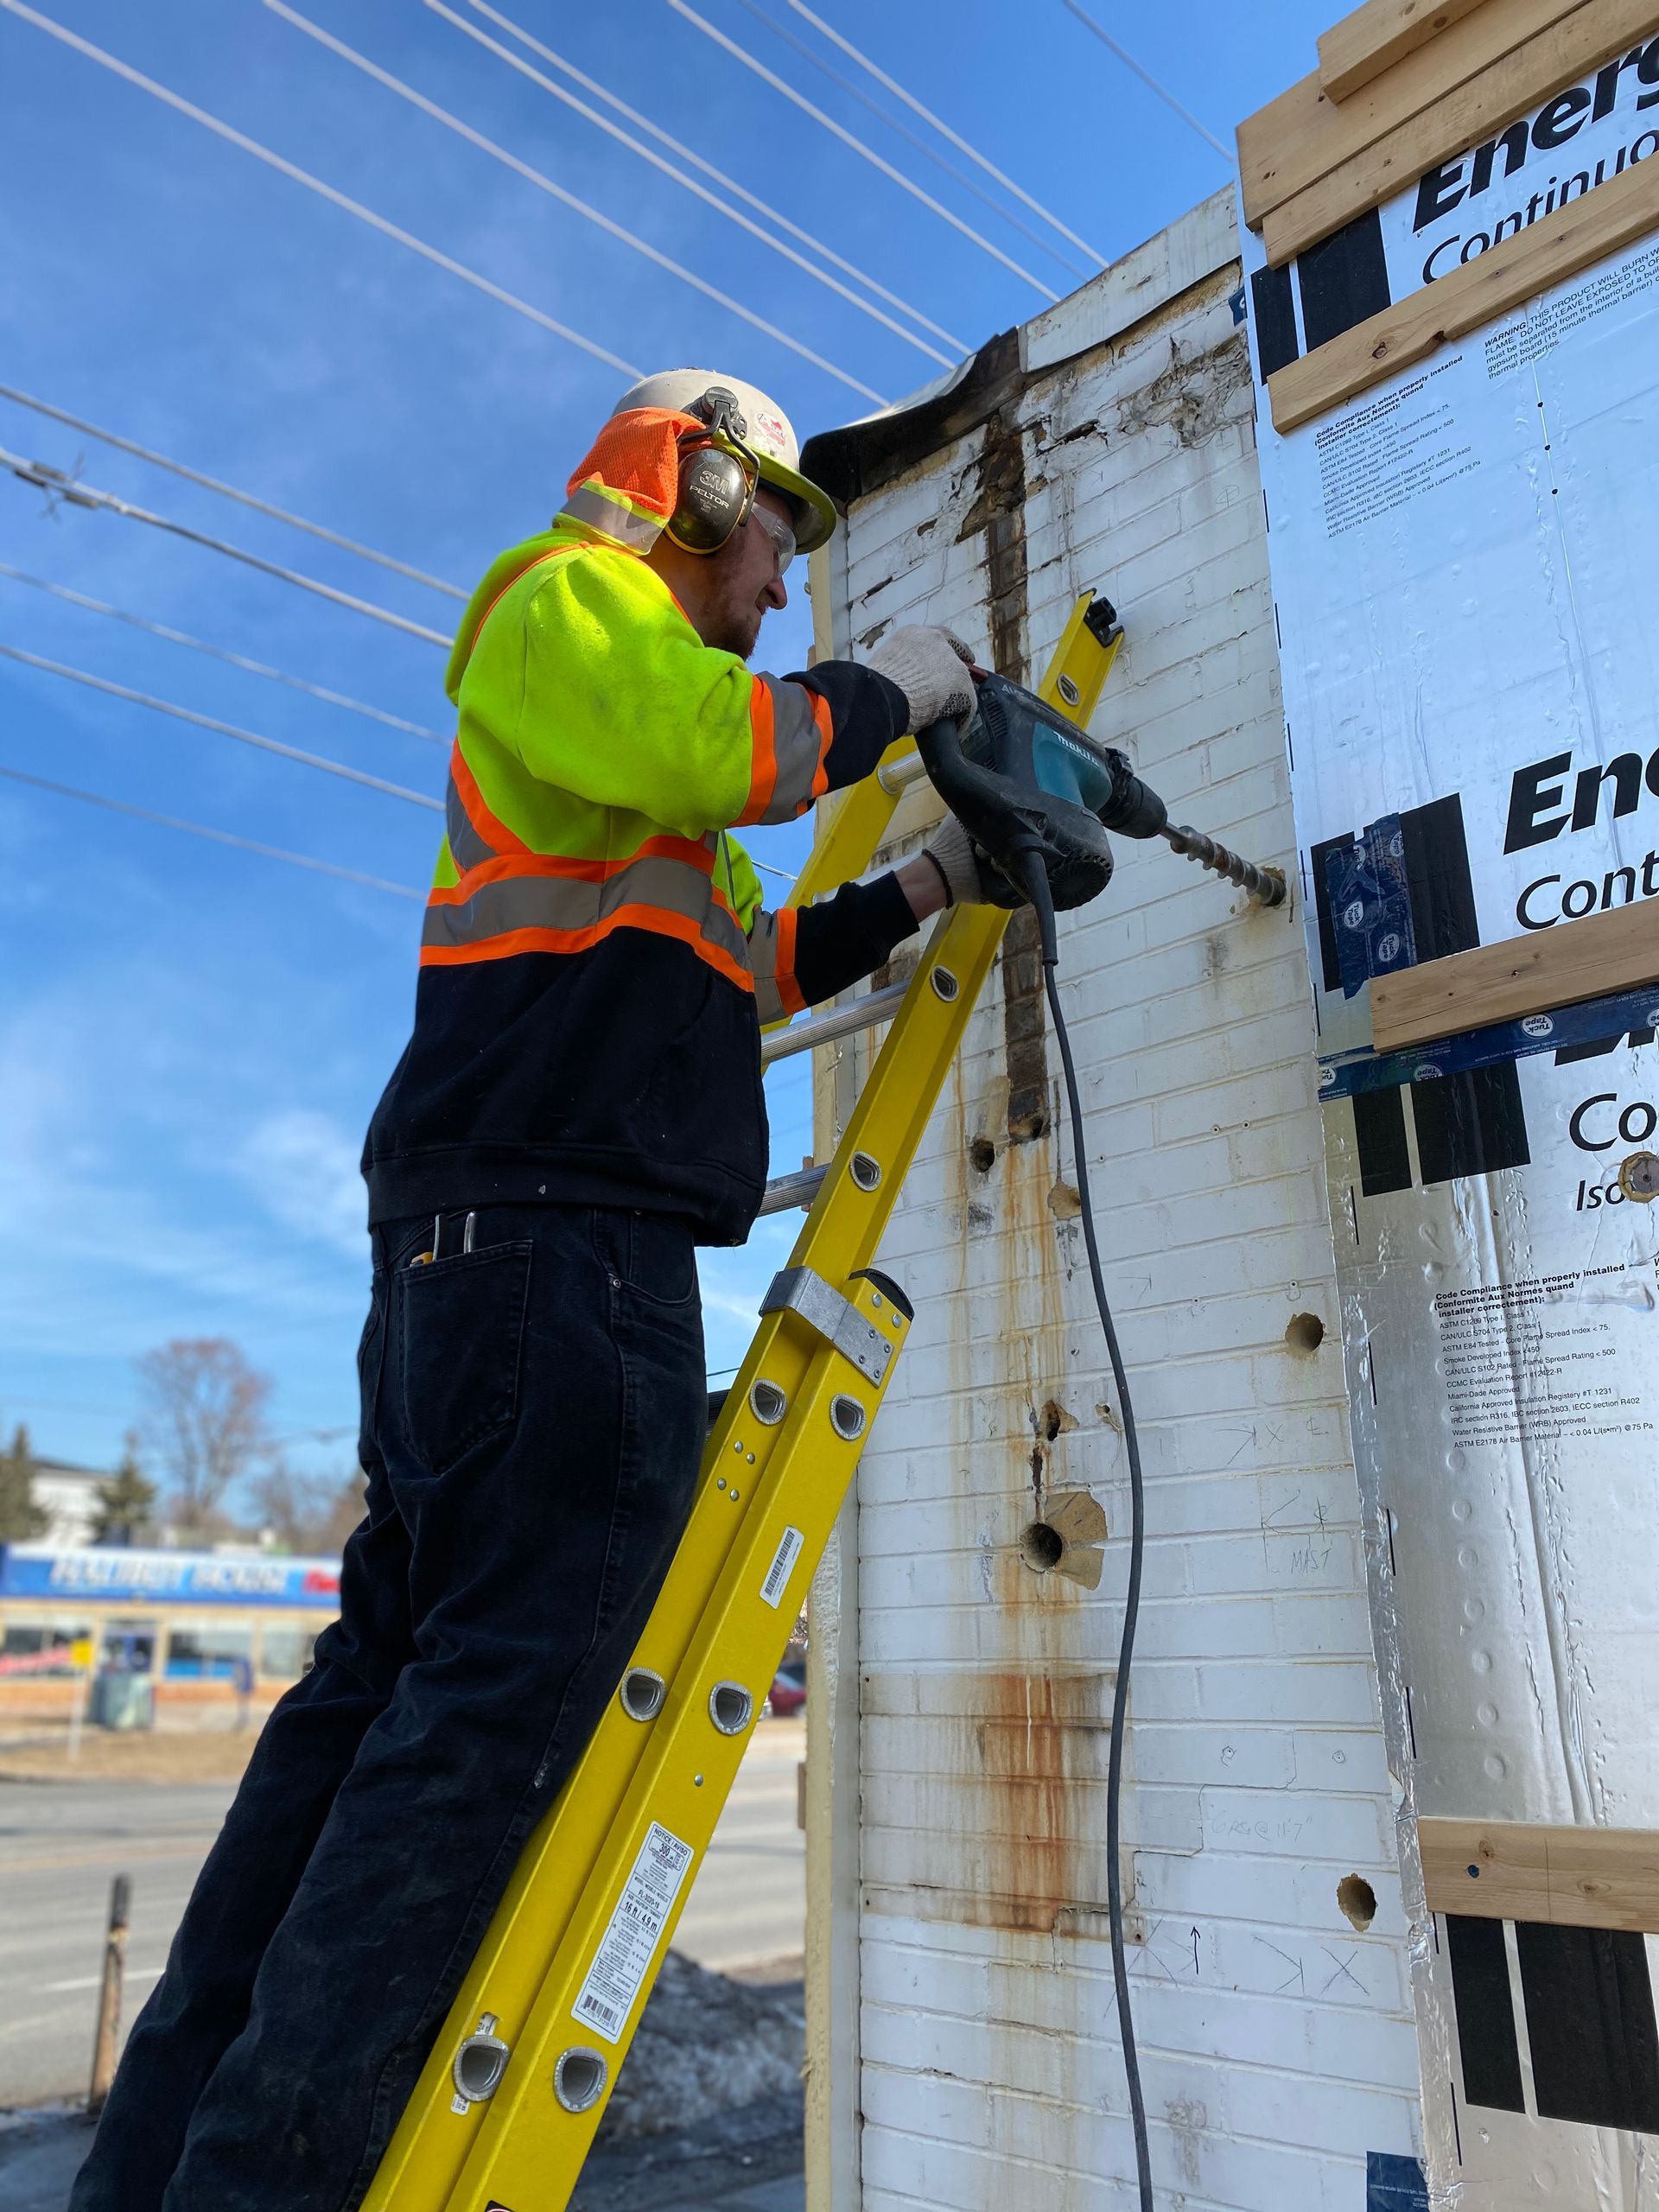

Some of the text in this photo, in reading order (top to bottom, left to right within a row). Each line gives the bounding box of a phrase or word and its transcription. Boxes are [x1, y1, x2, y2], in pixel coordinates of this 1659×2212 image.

[1530, 308, 1548, 322] THIS
[1551, 282, 1596, 311] PRODUCT
[1598, 270, 1618, 285] WILL
[1621, 253, 1649, 272] BURN
[1520, 326, 1533, 337] DO
[1535, 315, 1553, 328] NOT
[1555, 298, 1583, 318] LEAVE
[1586, 272, 1630, 301] EXPOSED
[1633, 264, 1646, 275] TO
[1486, 349, 1504, 364] must
[1507, 344, 1516, 353] be
[1519, 321, 1557, 346] separated
[1559, 311, 1578, 324] from
[1580, 302, 1592, 313] the
[1594, 287, 1623, 305] interior
[1625, 279, 1634, 289] of
[1487, 352, 1517, 373] gypsum
[1520, 338, 1541, 354] board
[1544, 330, 1556, 343] (15
[1559, 315, 1586, 334] minute
[1588, 296, 1619, 317] thermal
[1622, 278, 1653, 299] barrier)
[1488, 359, 1517, 379] thermal
[1316, 355, 1462, 438] Code Compliance when properly installed
[1357, 413, 1370, 423] Aux
[1372, 397, 1399, 415] Normes
[1401, 384, 1423, 400] quand
[1318, 432, 1346, 449] installer
[700, 470, 729, 495] 3M
[690, 485, 729, 510] PELTOR
[1053, 731, 1098, 767] makita
[1503, 747, 1659, 855] En
[1525, 1017, 1547, 1027] Tape
[1527, 1024, 1550, 1033] Tuck
[1459, 1284, 1511, 1295] Compliance
[1542, 1273, 1579, 1285] properly
[1583, 1265, 1624, 1276] installed
[1508, 1289, 1542, 1298] Normes
[1546, 1282, 1573, 1294] quand
[1439, 1296, 1544, 1317] installer correctement):
[1545, 1329, 1570, 1338] Spread
[1467, 1351, 1501, 1360] Developed
[1545, 1354, 1569, 1363] Spread
[1505, 1372, 1528, 1381] Report
[1488, 1386, 1520, 1395] Approved
[1481, 1399, 1512, 1408] Approved
[1515, 1395, 1546, 1404] Insulation
[1553, 1416, 1586, 1426] Approved
[654, 1827, 672, 1847] NOTICE
[659, 1843, 671, 1858] 300
[625, 1901, 632, 1912] 16
[642, 1914, 651, 1927] 4.9
